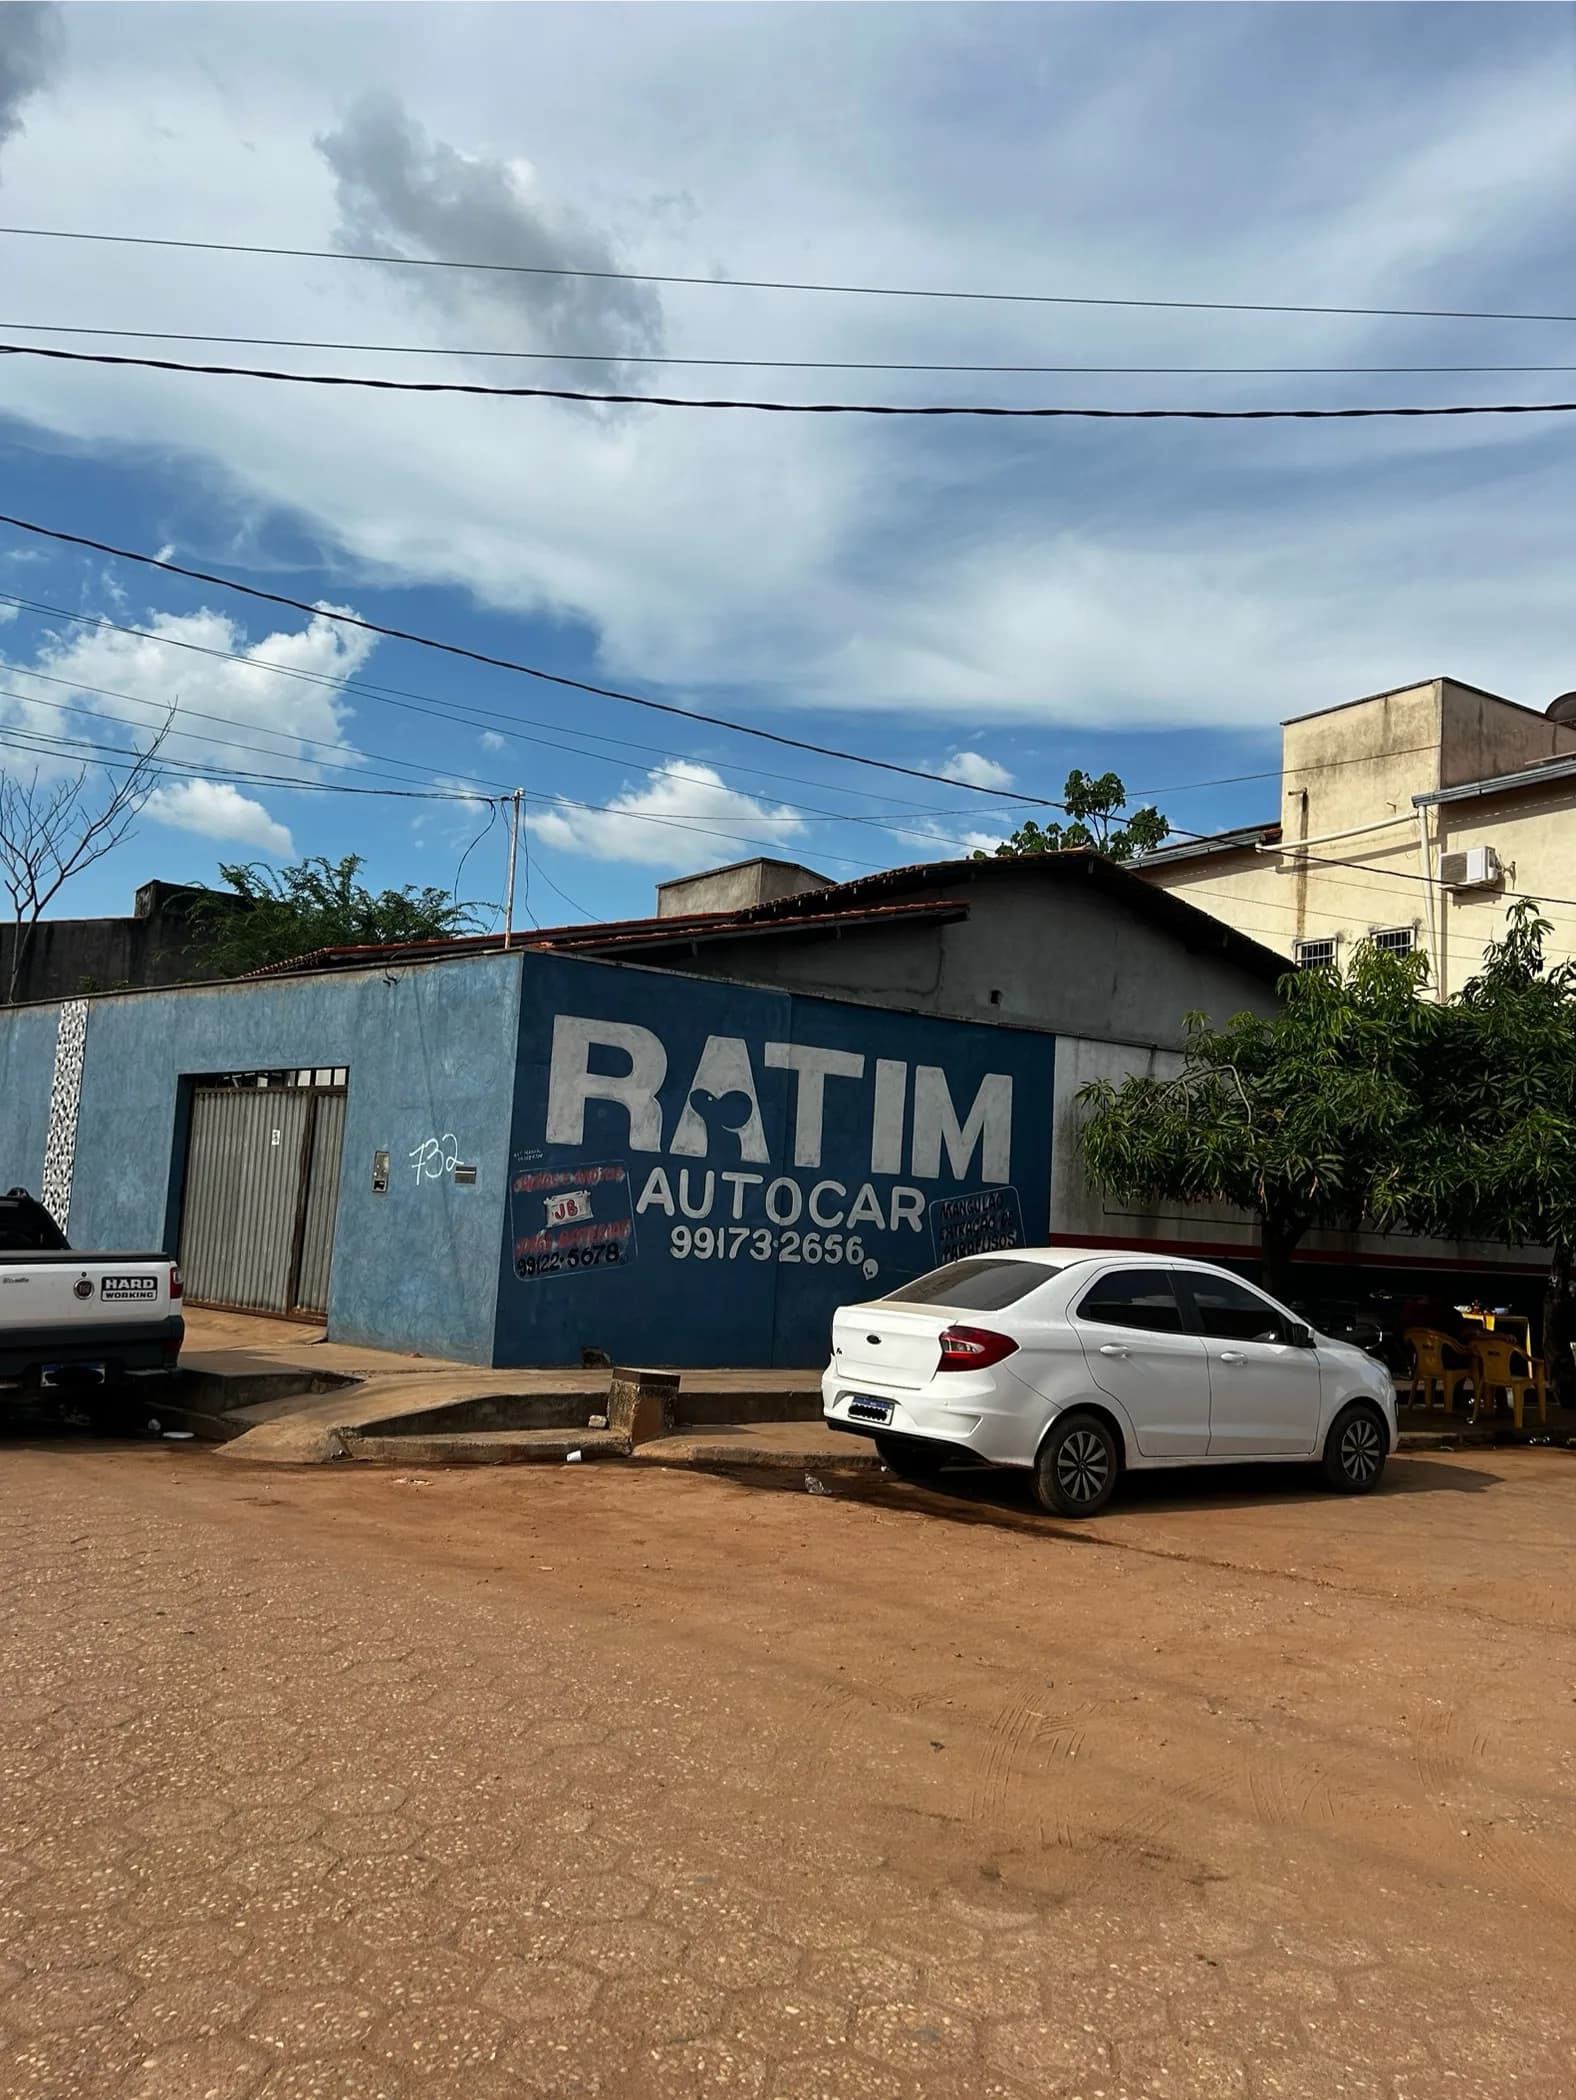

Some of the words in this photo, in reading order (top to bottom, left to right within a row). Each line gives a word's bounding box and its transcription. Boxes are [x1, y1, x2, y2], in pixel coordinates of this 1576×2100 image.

[545, 1014, 1013, 1184] RATIM
[409, 1133, 464, 1186] 732
[635, 1166, 926, 1233] AUTOCAR
[105, 1279, 154, 1290] HARD
[105, 1292, 154, 1300] WORKING
